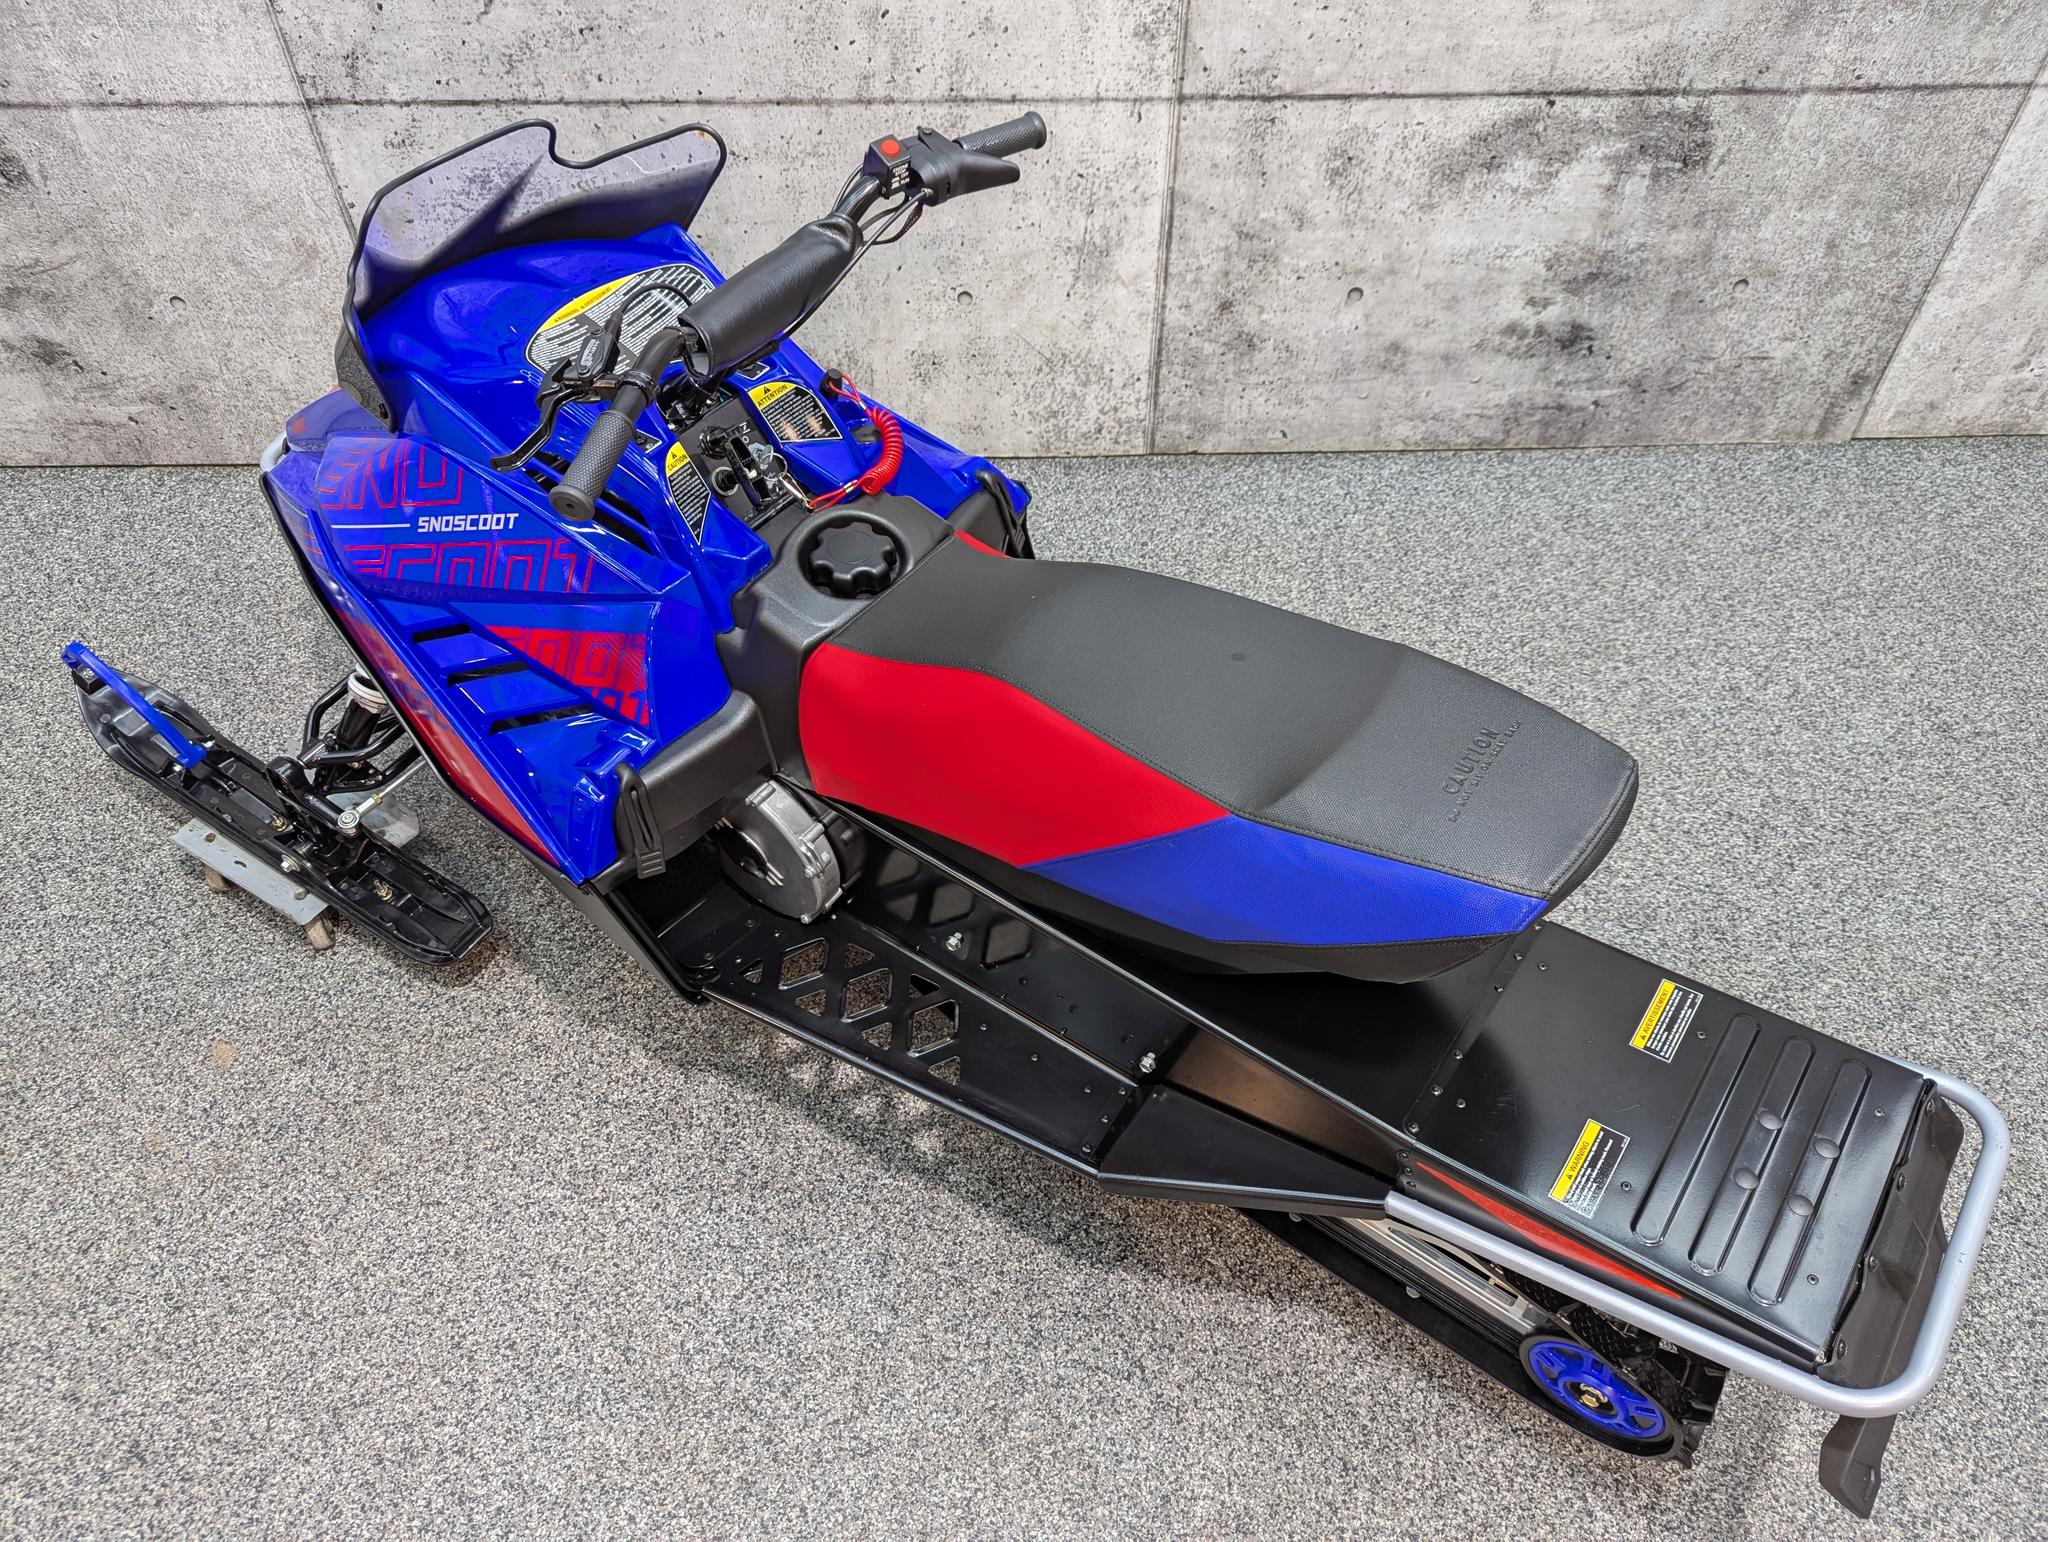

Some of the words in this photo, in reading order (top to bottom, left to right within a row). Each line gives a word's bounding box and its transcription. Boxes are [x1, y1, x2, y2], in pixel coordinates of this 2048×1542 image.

[757, 383, 788, 408] ATTENTION
[667, 454, 688, 472] CAUTION
[417, 512, 519, 533] SNOSCOOT
[1441, 727, 1500, 795] CAUTION
[1643, 988, 1670, 1035] AVERTISSEMENT
[1568, 1140, 1590, 1174] WARNING
